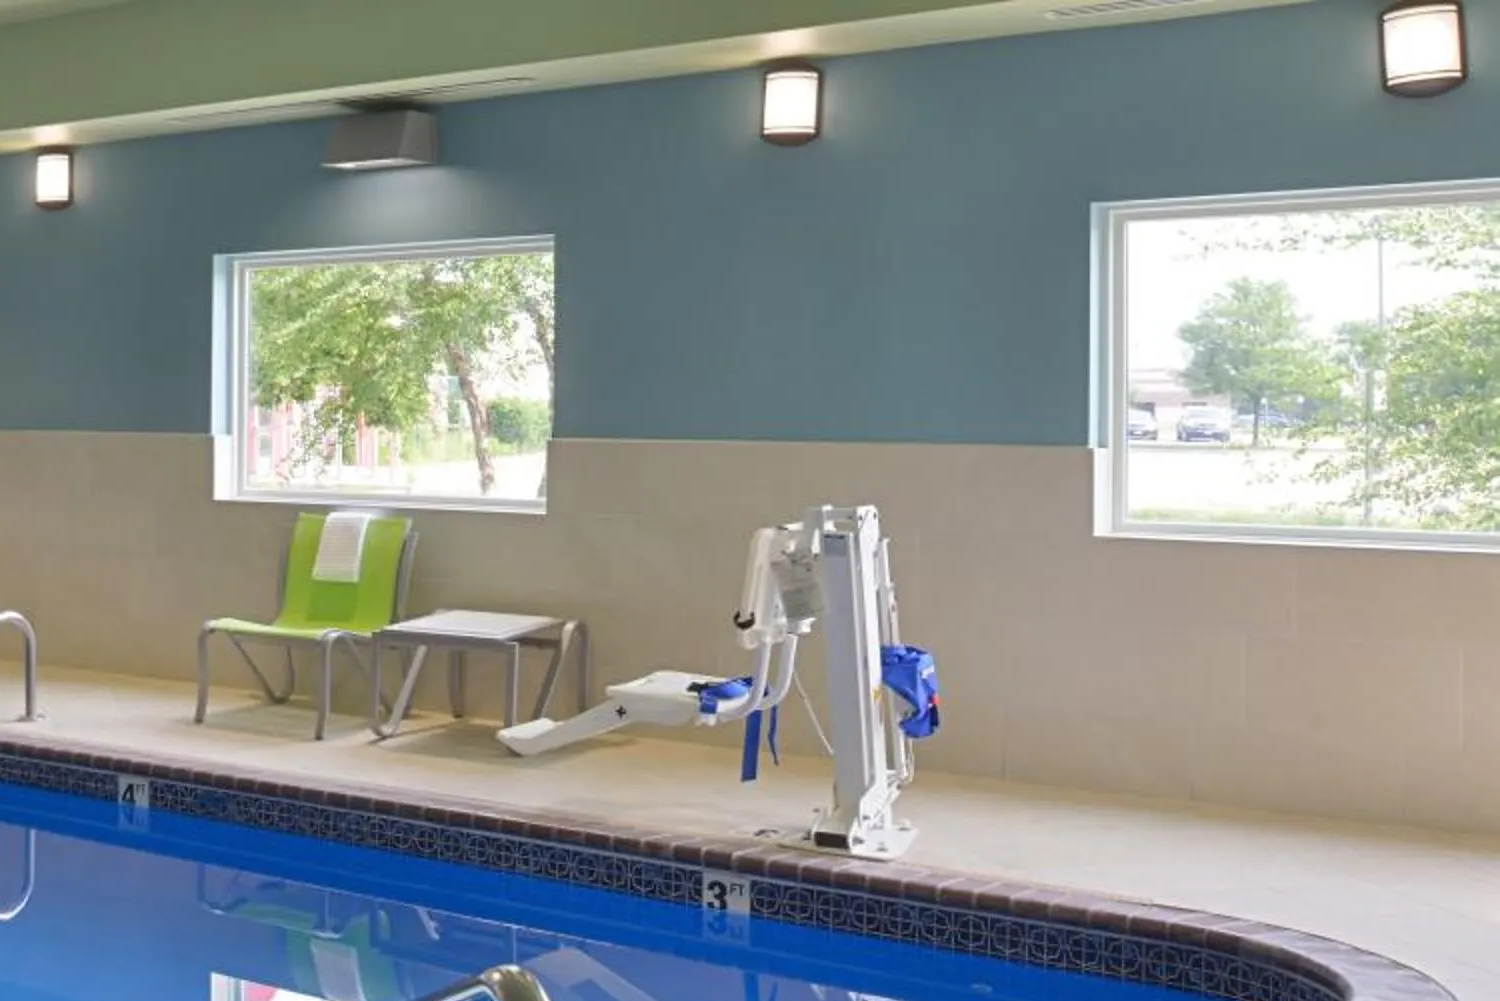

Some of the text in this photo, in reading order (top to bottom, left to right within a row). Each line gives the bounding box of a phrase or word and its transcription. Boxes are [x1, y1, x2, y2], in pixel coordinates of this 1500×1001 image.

[121, 783, 135, 803] 4
[707, 880, 745, 911] 3 FT
